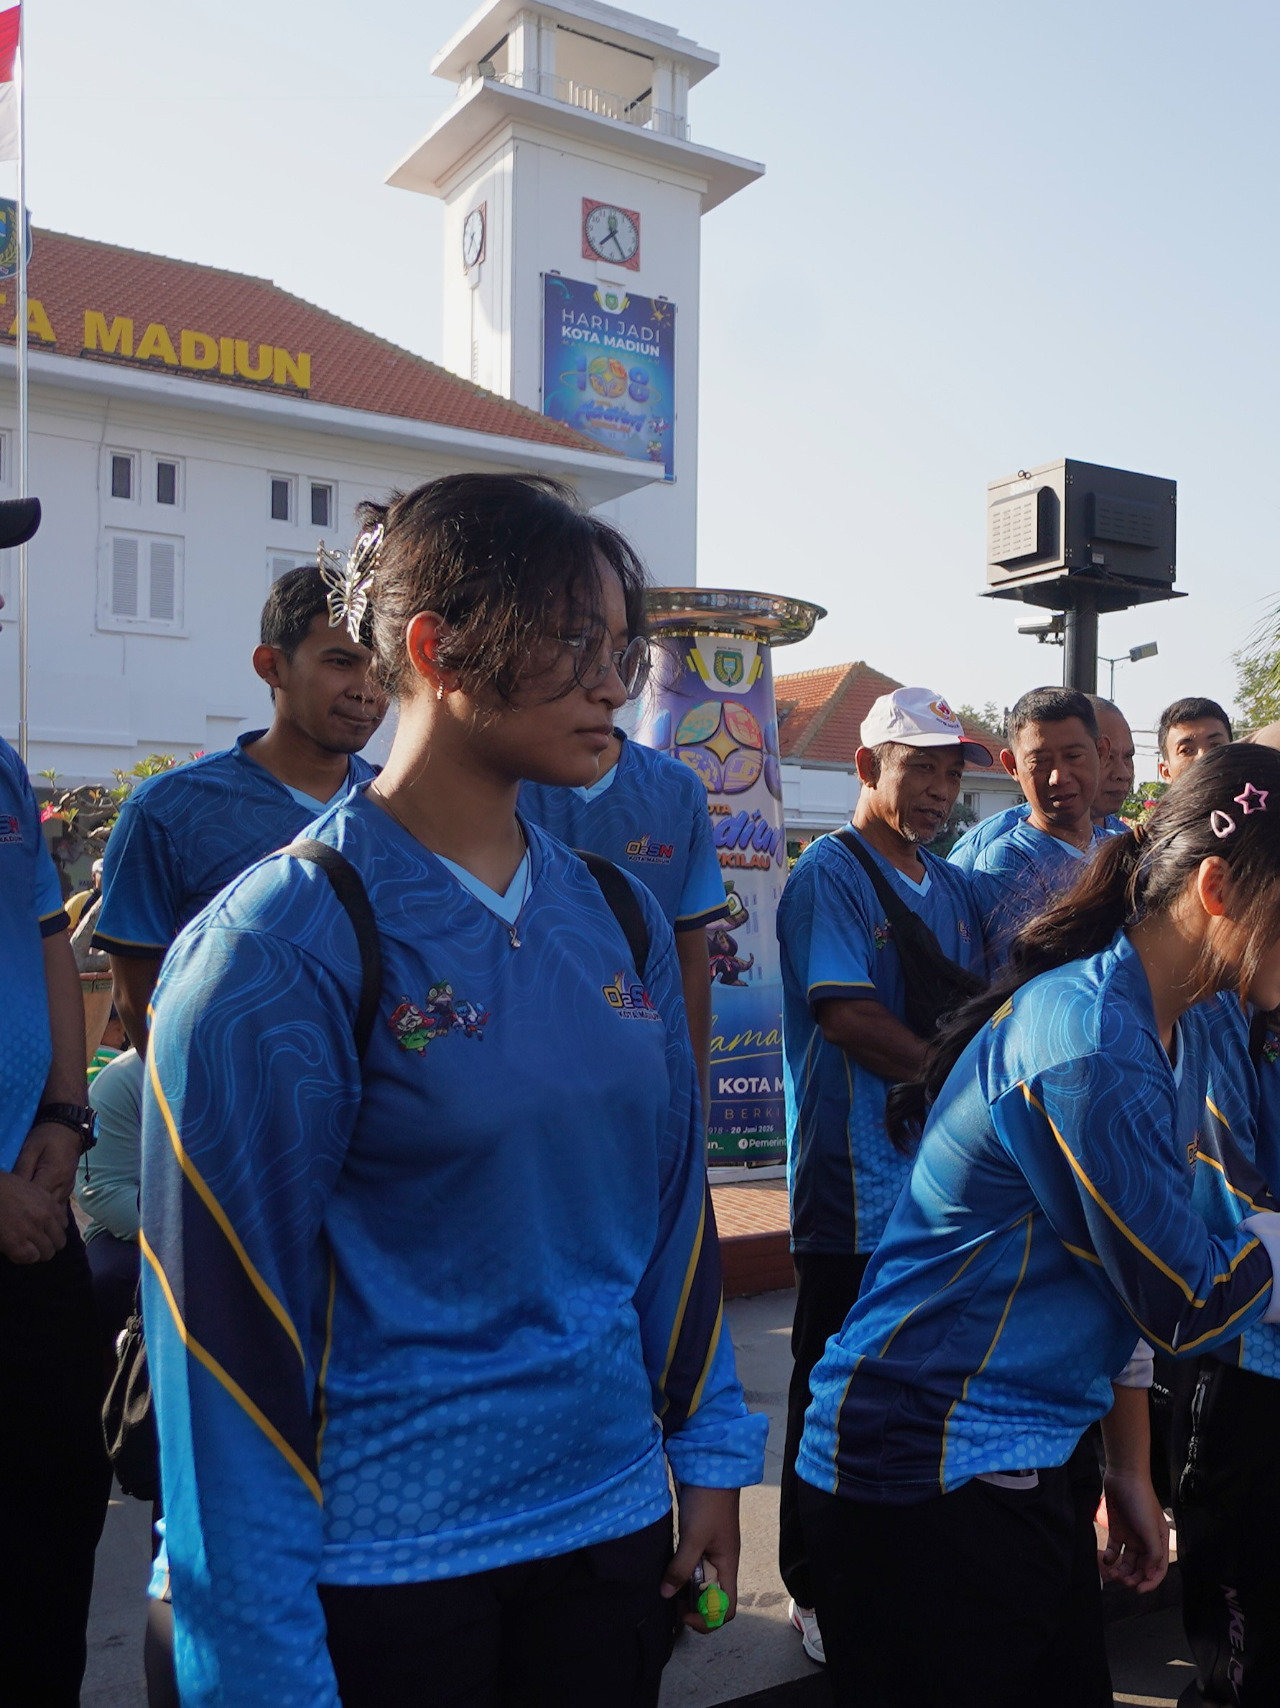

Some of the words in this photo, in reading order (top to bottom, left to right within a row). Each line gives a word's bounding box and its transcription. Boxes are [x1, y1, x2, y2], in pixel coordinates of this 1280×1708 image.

[562, 308, 609, 332] HARI
[617, 321, 660, 343] JADI
[84, 309, 310, 389] MADIUN
[562, 326, 600, 344] KOTA
[604, 337, 660, 358] MADIUN
[707, 804, 732, 815] OTA
[713, 809, 785, 868] diun
[718, 852, 771, 871] KILAU
[718, 1076, 771, 1094] KOTA
[725, 1107, 780, 1120] BERKI
[731, 1126, 742, 1134] 20
[749, 1137, 786, 1148] Pemerint
